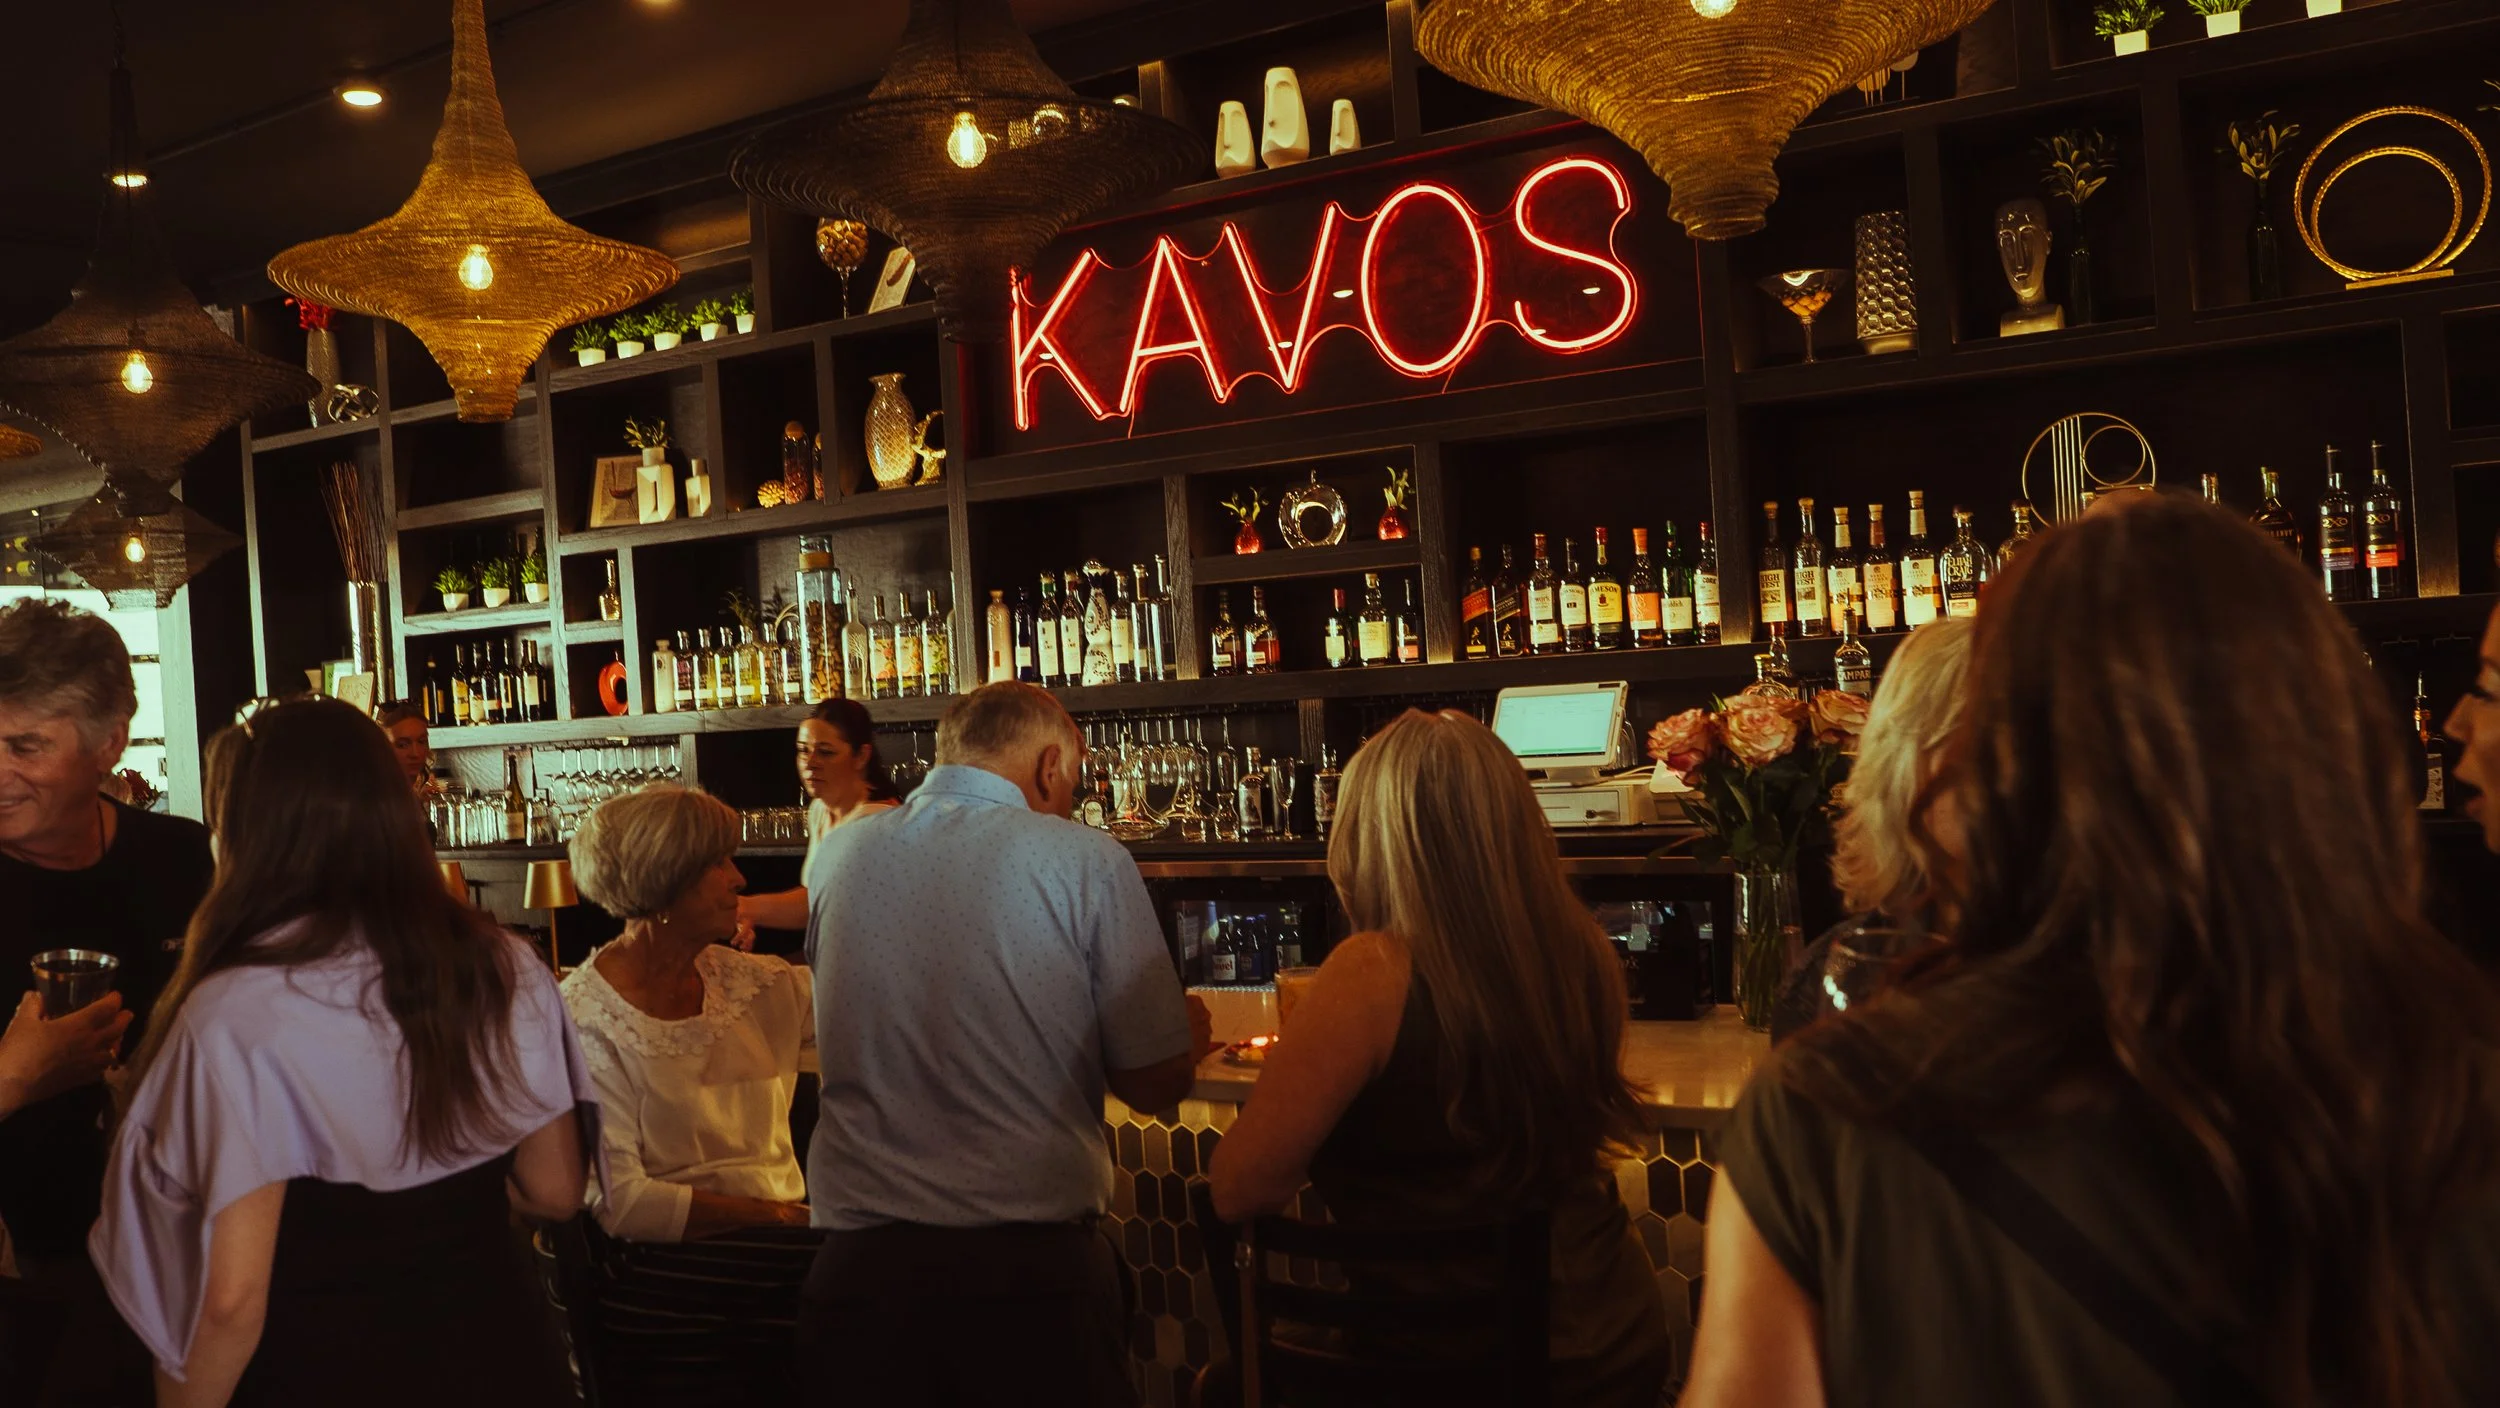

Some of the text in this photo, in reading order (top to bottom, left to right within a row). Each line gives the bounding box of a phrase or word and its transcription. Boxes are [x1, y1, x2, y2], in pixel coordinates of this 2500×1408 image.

[1011, 157, 1637, 430] KAVOS
[1947, 555, 1973, 567] ELIJAH
[1946, 566, 1973, 577] CRAIG
[1590, 585, 1618, 594] AMESON
[1836, 669, 1871, 681] AMPAR
